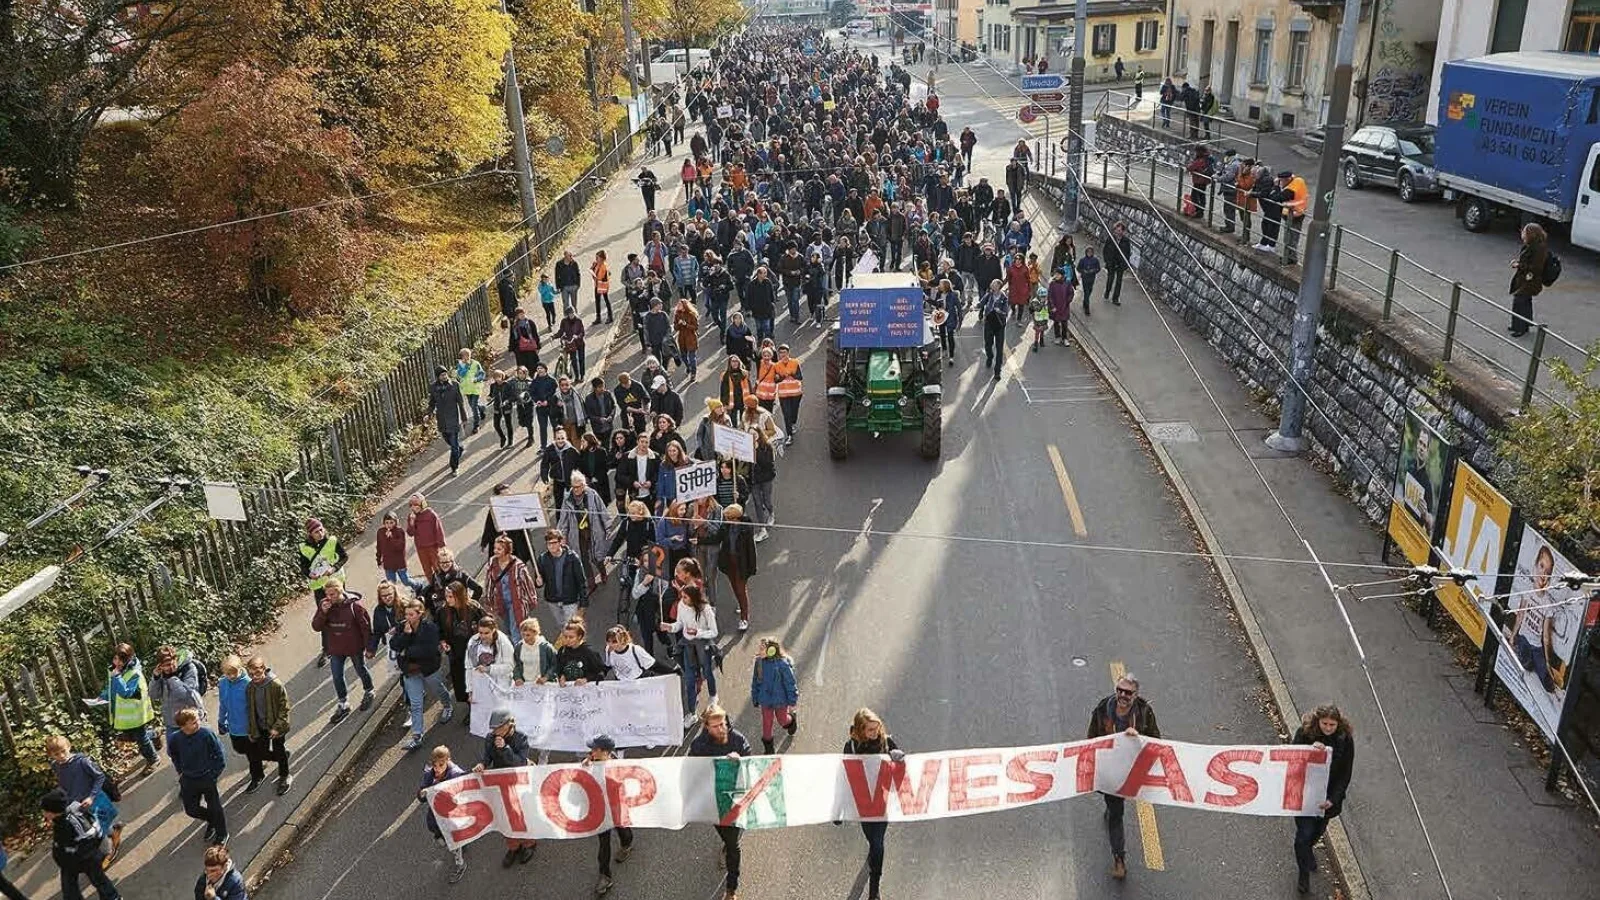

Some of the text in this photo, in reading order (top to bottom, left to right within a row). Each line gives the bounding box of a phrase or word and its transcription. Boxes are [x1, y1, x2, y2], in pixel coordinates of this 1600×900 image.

[1484, 98, 1530, 118] VEREIN
[1480, 117, 1557, 145] FUNDAMENT
[679, 466, 716, 494] STOP
[1443, 494, 1501, 614] JA
[432, 764, 658, 843] STOP
